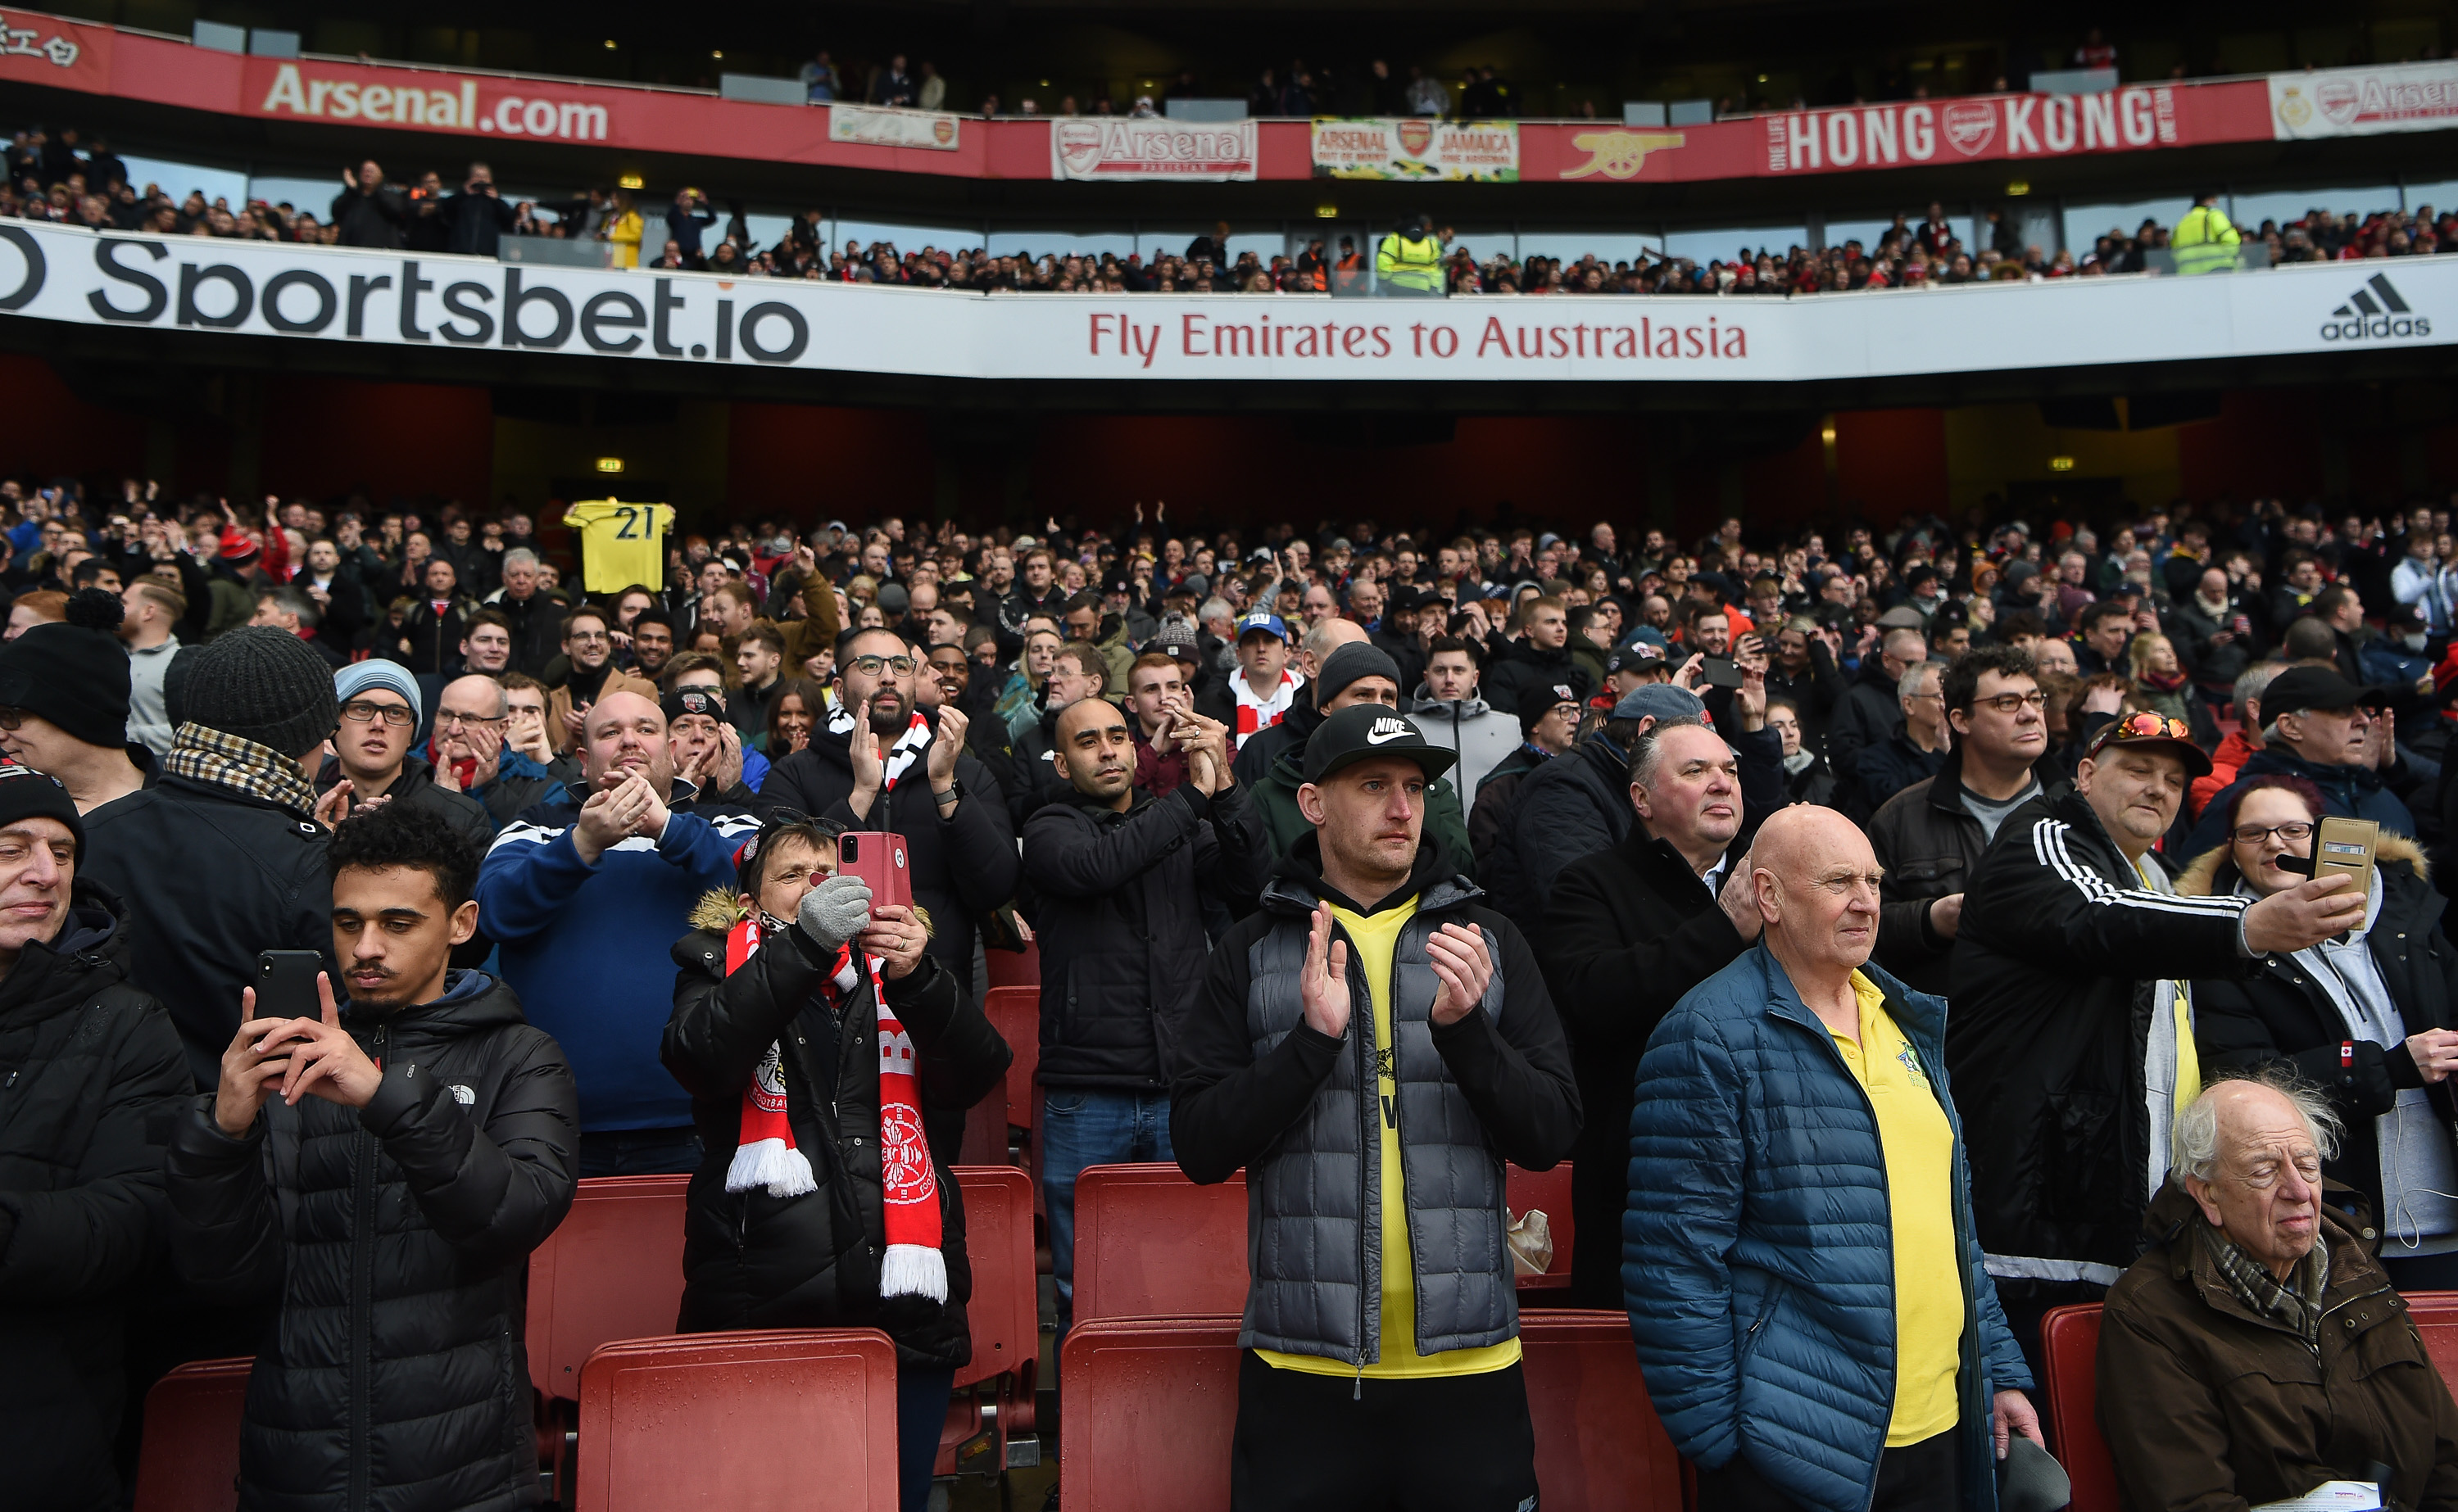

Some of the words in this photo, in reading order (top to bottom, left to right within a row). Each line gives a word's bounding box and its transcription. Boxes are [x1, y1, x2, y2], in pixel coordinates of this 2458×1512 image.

[263, 64, 609, 141] Arsenal.com
[1101, 123, 1254, 159] Arsenal
[1319, 132, 1388, 150] ARSENAL
[1440, 134, 1511, 153] JAMAICA
[1789, 106, 1935, 169] HONG
[2005, 88, 2155, 154] KONG
[87, 238, 808, 365] Sportsbet.io
[1090, 314, 1160, 369] Fly
[1183, 315, 1392, 359] Emirates
[1410, 321, 1459, 359] to
[1477, 316, 1748, 359] Australasia
[2320, 314, 2431, 342] adidas
[614, 506, 654, 541] 21
[1374, 718, 1405, 733] NIKE
